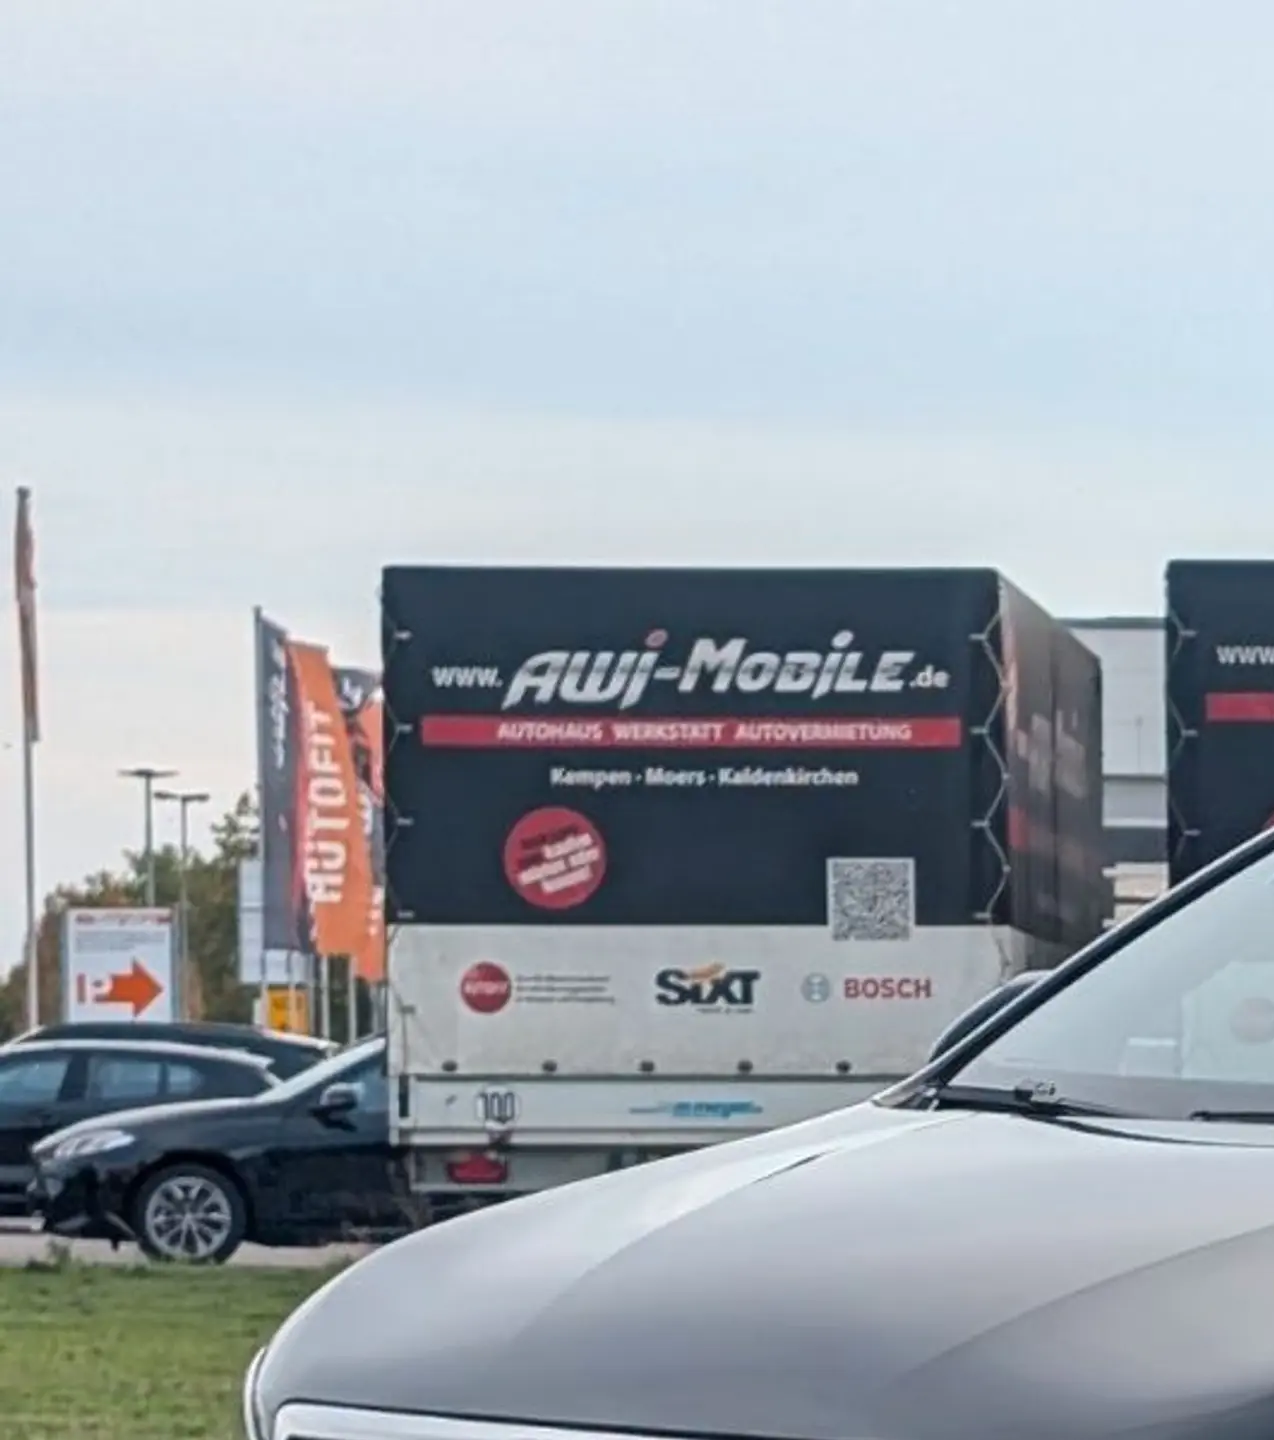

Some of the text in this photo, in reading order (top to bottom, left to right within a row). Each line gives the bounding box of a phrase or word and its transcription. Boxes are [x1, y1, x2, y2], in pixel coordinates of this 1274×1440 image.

[497, 722, 913, 742] AUTOHAUS WERKSTATT AUTOVERMIETUNG
[551, 767, 632, 790] Kempen
[645, 768, 706, 786] Moers
[844, 977, 932, 999] BOSCH
[479, 1091, 516, 1122] 100
